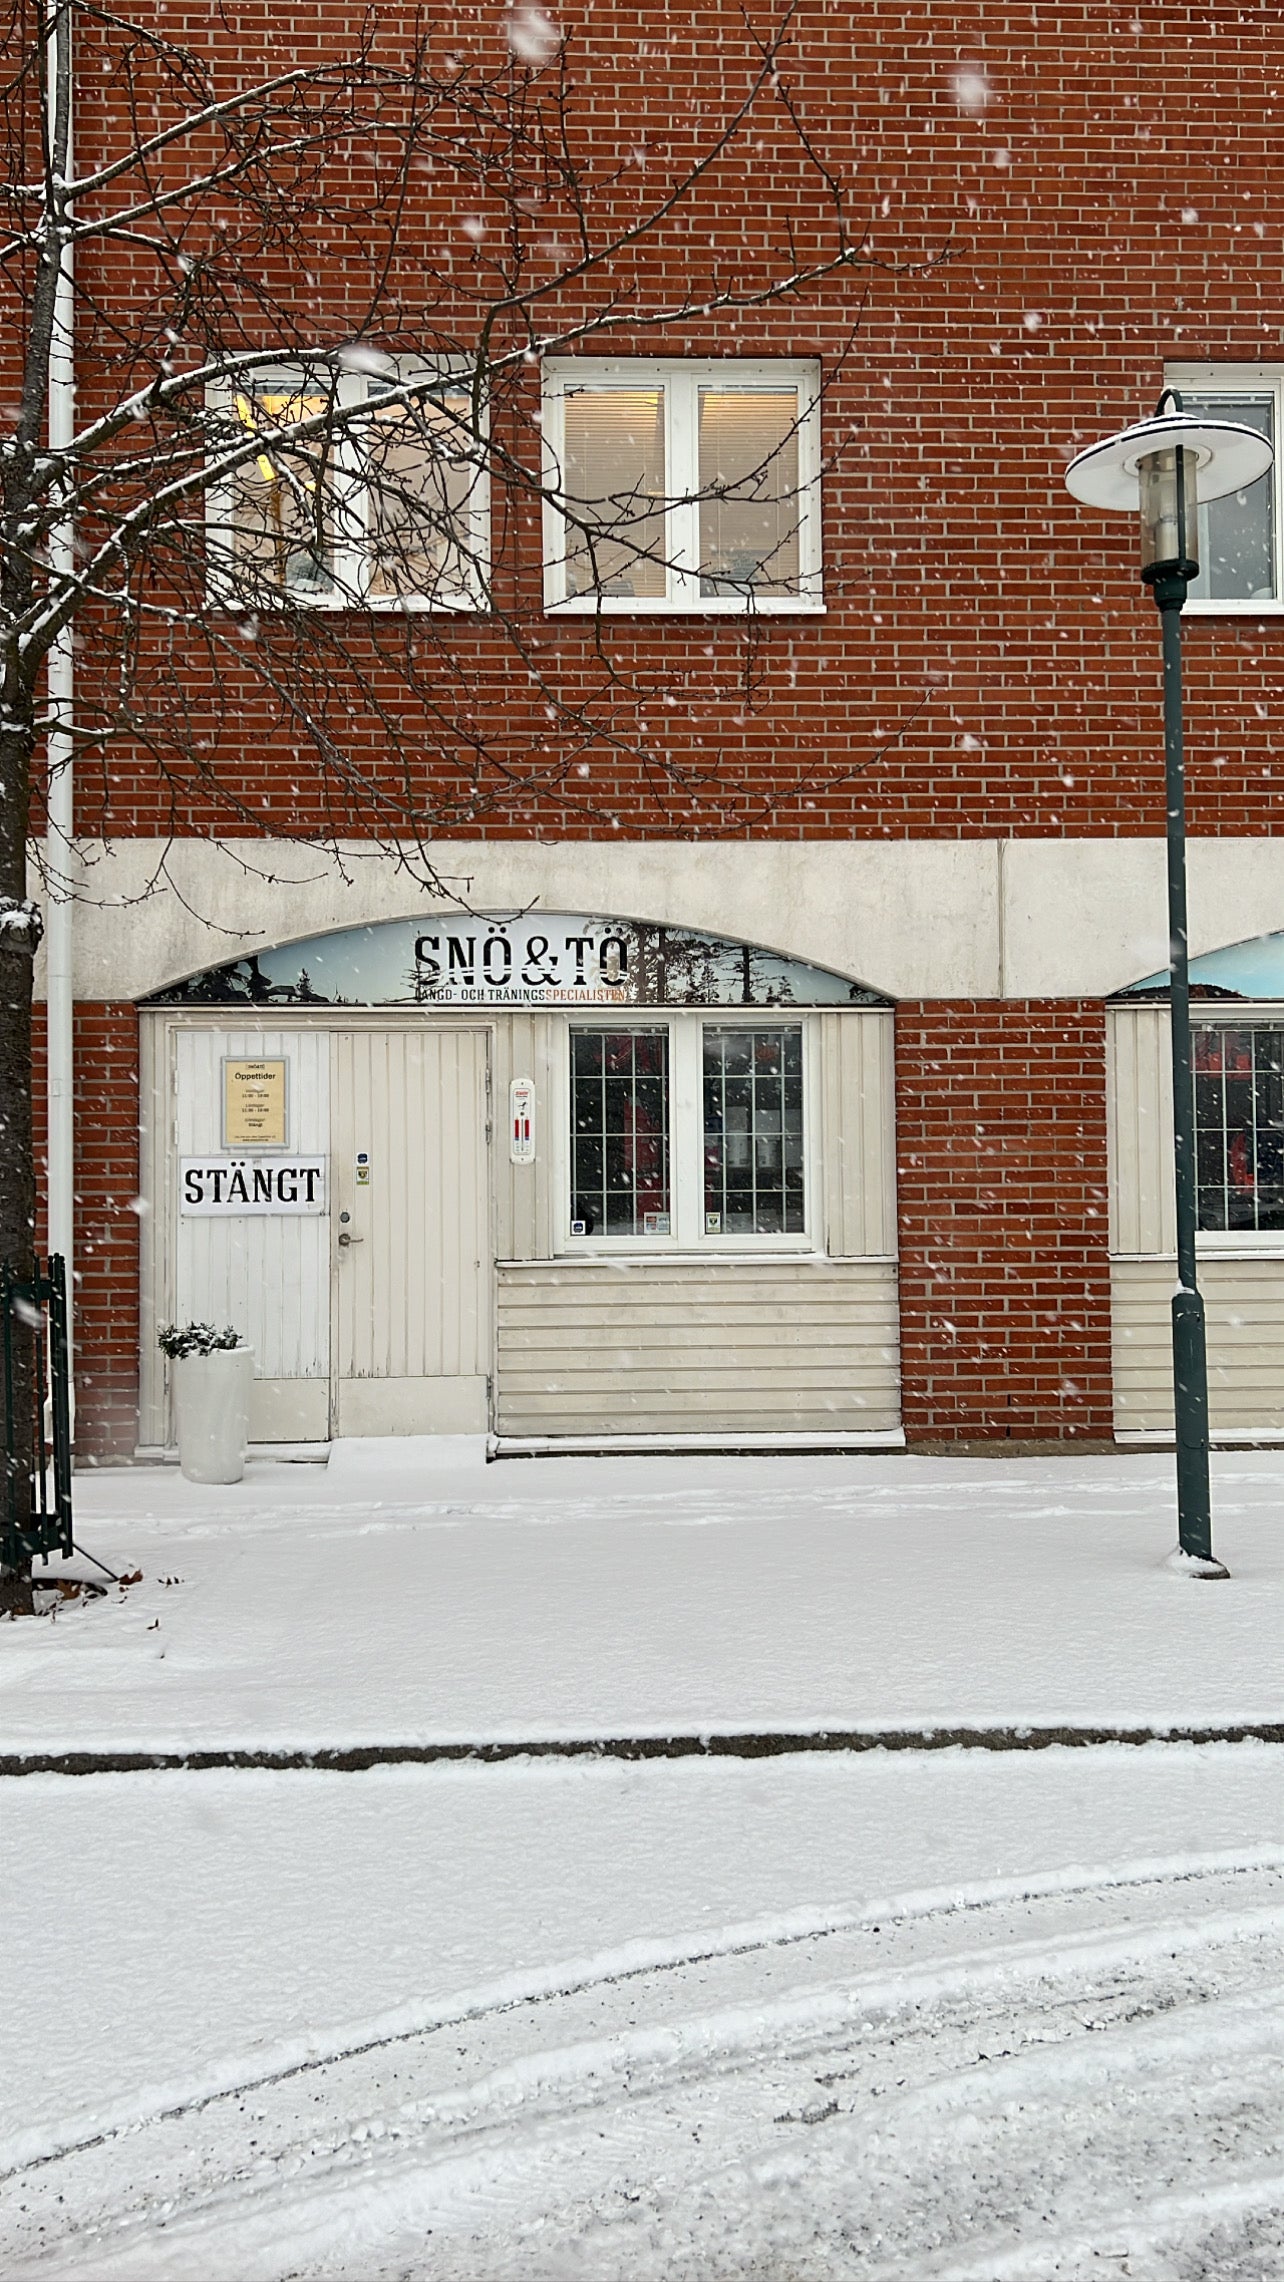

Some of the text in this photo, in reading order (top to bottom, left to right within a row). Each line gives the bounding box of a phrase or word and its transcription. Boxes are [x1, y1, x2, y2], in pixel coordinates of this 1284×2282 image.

[415, 926, 628, 986] SNÖ&TÖ
[461, 989, 484, 1001] OCH
[185, 1161, 320, 1204] STÄNGT
